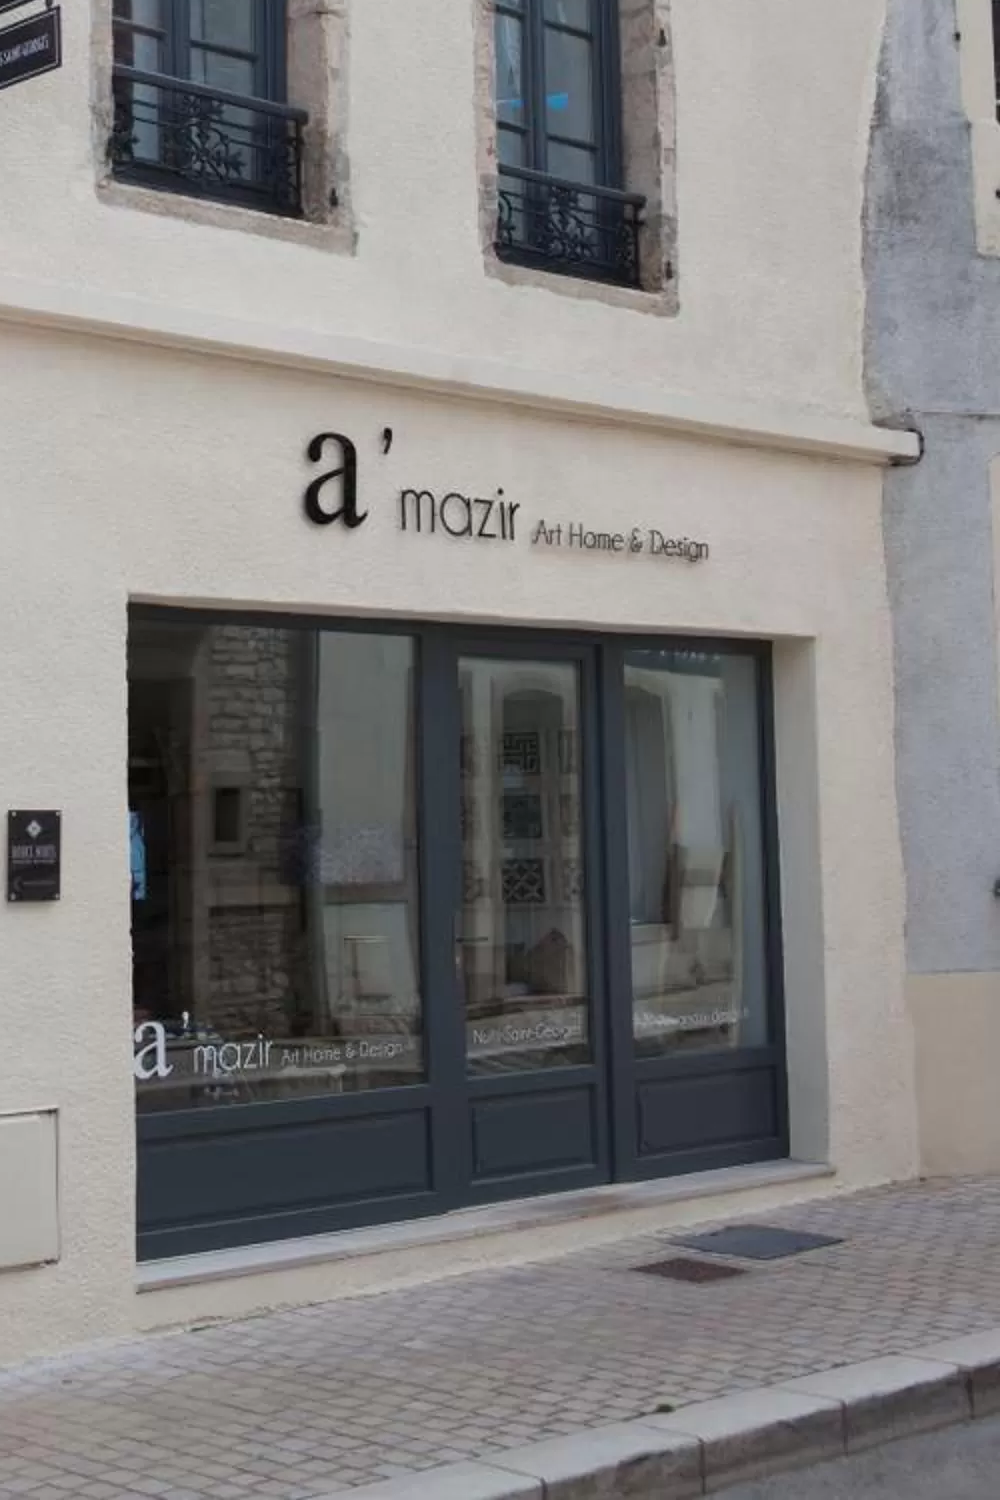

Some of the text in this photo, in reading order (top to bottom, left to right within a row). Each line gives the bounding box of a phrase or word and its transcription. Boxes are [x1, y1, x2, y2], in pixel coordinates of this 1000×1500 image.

[532, 519, 562, 546] Art
[569, 522, 625, 553] Home
[629, 527, 643, 553] &
[649, 529, 709, 563] Design
